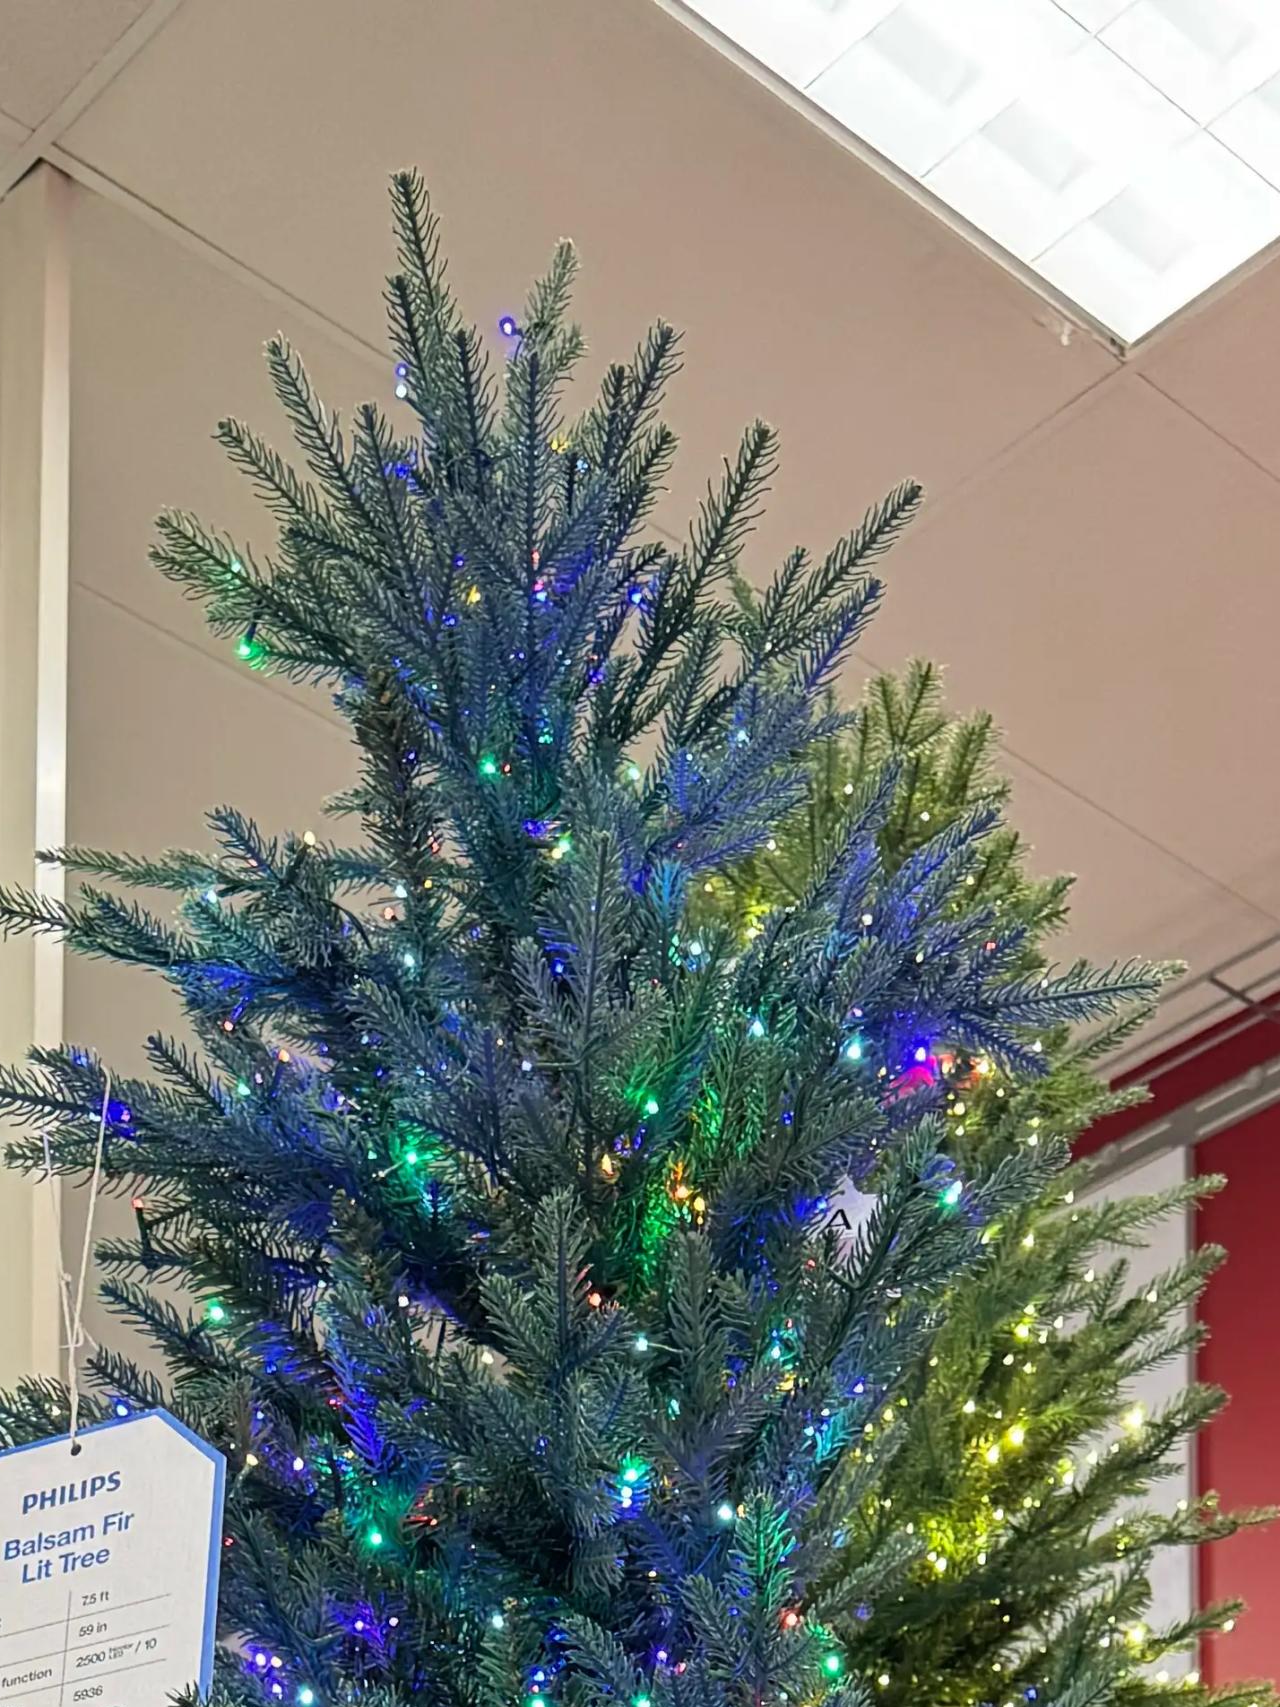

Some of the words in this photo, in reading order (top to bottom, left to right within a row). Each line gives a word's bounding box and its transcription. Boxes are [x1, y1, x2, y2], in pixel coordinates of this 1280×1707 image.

[22, 1471, 121, 1515] PHILIPS
[4, 1524, 94, 1561] Balsam
[102, 1511, 135, 1536] Fir
[22, 1560, 53, 1584] Lit
[59, 1548, 110, 1573] Tree
[100, 1591, 109, 1602] ft
[79, 1624, 94, 1637] 59
[96, 1621, 107, 1634] in
[76, 1651, 106, 1668] 2500
[145, 1637, 157, 1651] 10
[1, 1667, 52, 1690] function
[73, 1685, 104, 1702] 5936
